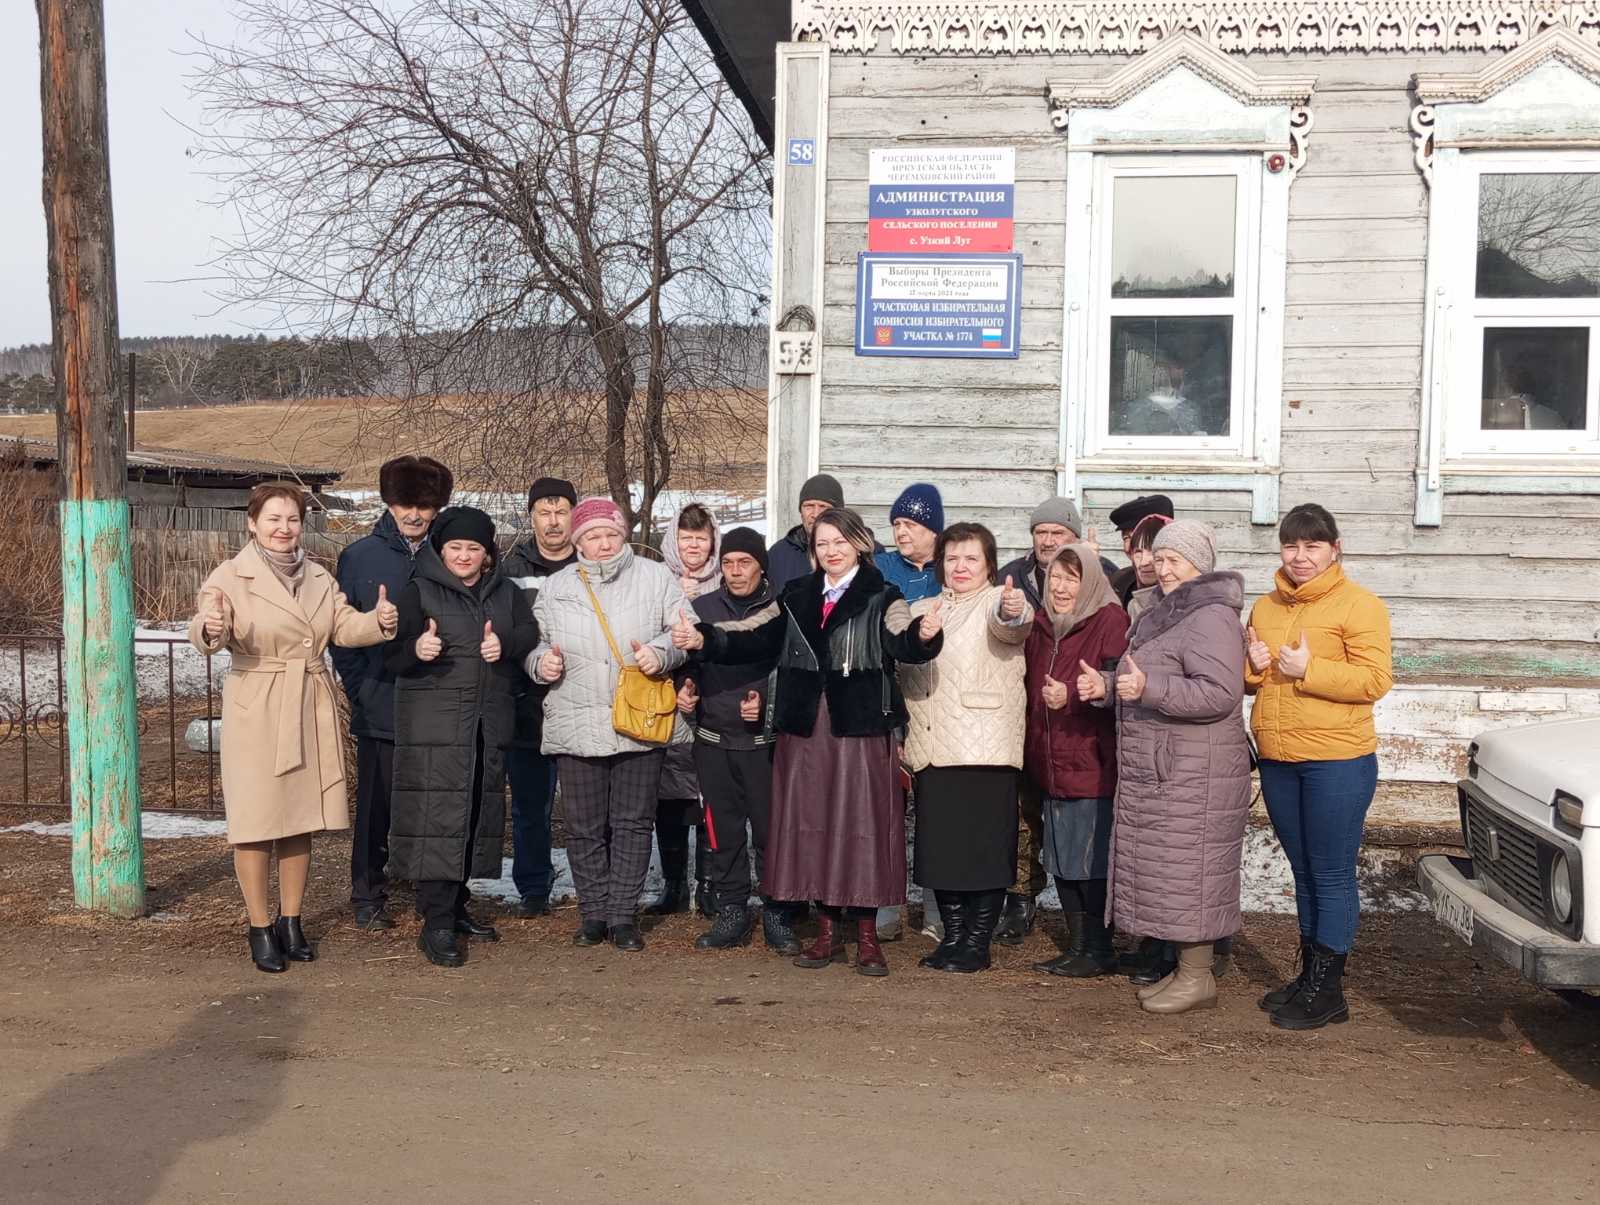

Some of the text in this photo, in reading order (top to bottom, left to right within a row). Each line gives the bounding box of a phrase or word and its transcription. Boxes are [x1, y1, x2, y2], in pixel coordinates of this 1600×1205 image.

[791, 143, 813, 160] 58
[882, 155, 944, 163] РОССИЙСКАЯ
[892, 164, 947, 172] ИРКУТСКАЯ
[888, 172, 996, 181] ЧЕРЕМХОВСКИЙ РАЙОН
[876, 191, 1005, 204] АДМИНИСТРАЦИЯ
[905, 207, 978, 217] УЗКОЛУГСКОГО
[883, 220, 998, 230] СЕЛЬСКОГО ПОСЕЛЕНИЯ
[920, 235, 951, 246] Узкий
[952, 236, 972, 247] Луг
[889, 266, 991, 278] Выборы Президента
[881, 277, 999, 290] Российской Федерации
[873, 302, 1006, 313] УЧАСТКОВАЯ ИЗБИРАТЕЛЬНАЯ
[873, 316, 1004, 327] КОМИССИЯ ИЗБИРАТЕЛЬНОГО
[903, 331, 943, 341] УЧАСТКА
[944, 331, 954, 341] №
